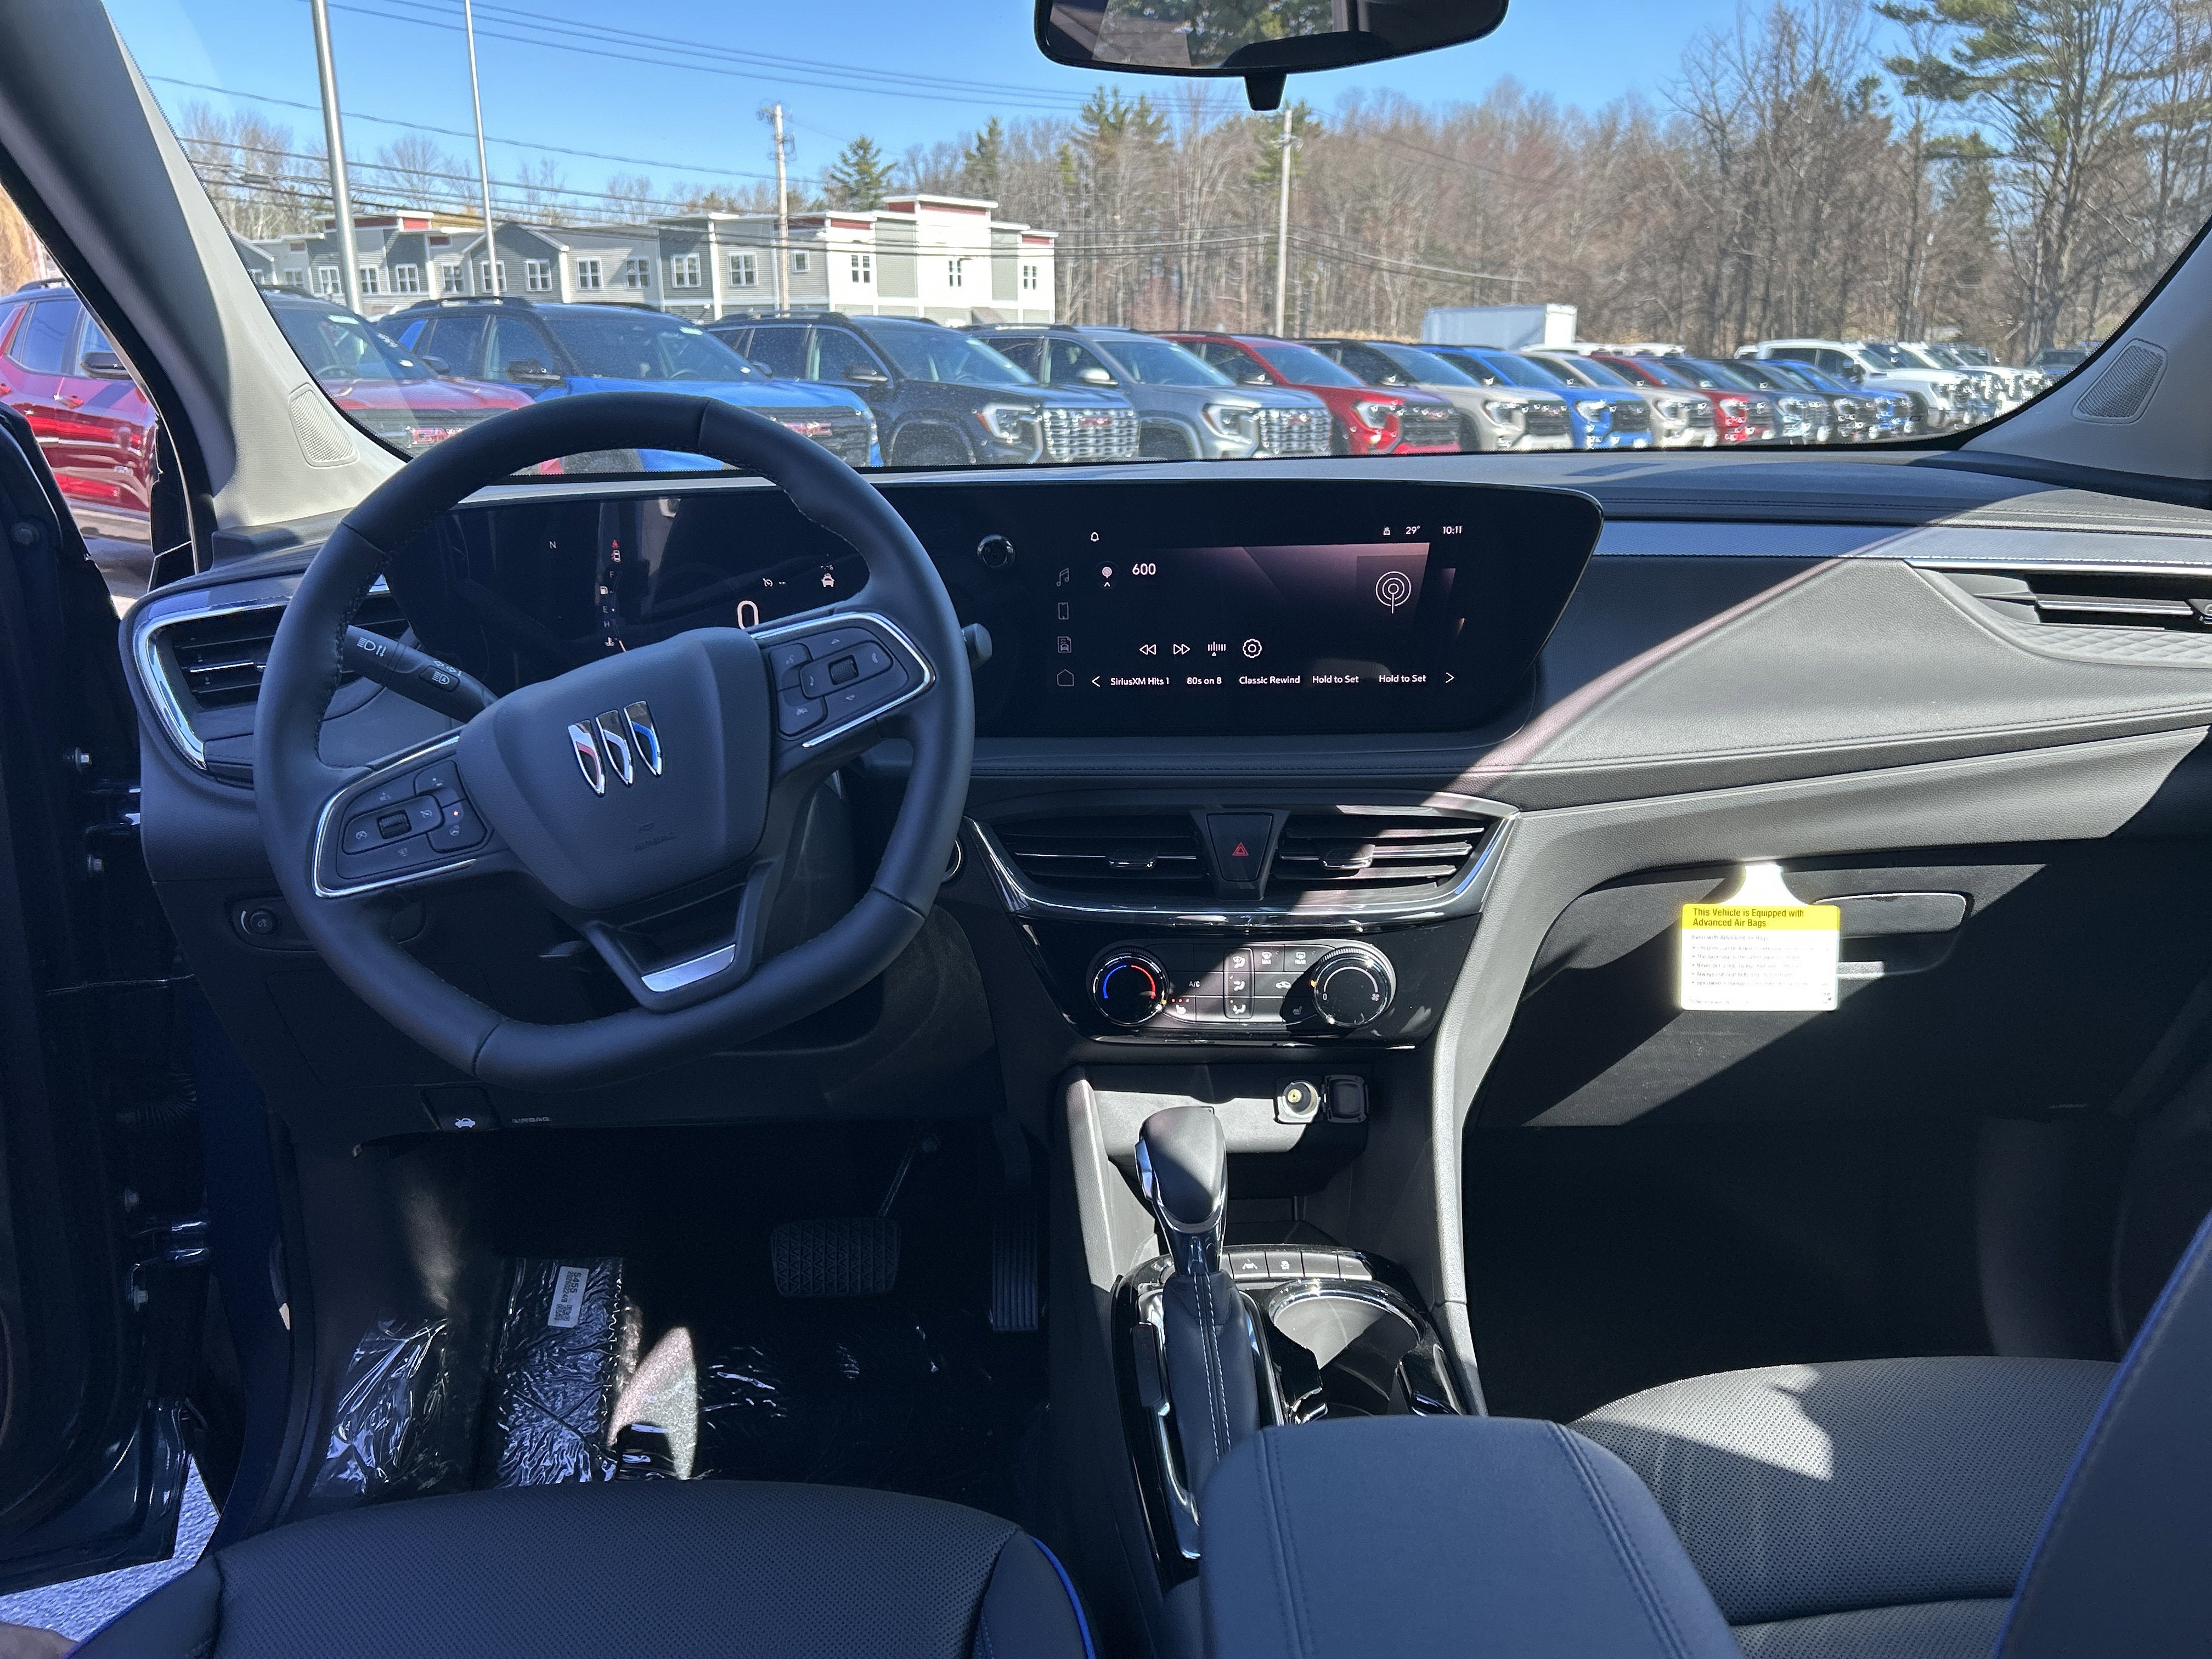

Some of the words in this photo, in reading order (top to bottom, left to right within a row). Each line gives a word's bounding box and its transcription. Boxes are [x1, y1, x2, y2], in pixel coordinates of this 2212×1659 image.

[1406, 525, 1420, 534] 29°
[1442, 526, 1462, 534] 10:11
[549, 540, 557, 549] N
[1132, 563, 1156, 575] 600
[737, 600, 759, 630] 0
[1110, 677, 1146, 686] SiriusXM
[1148, 677, 1164, 685] Hits
[1187, 676, 1203, 685] 80s
[1216, 676, 1222, 685] 8
[1239, 676, 1268, 685] Classic
[1269, 675, 1300, 684] Rewind
[1312, 675, 1332, 684] Hold
[1334, 675, 1343, 684] to
[1345, 675, 1359, 684] Set
[1379, 674, 1399, 682] Hold
[1412, 674, 1426, 682] Set
[1693, 908, 1710, 917] This
[1712, 908, 1741, 917] Vehicle
[1743, 909, 1750, 917] is
[1752, 909, 1786, 919] Equipped
[1788, 910, 1804, 918] with
[1692, 918, 1732, 927] Advanced
[1734, 918, 1746, 927] Air
[1747, 918, 1767, 928] Bags
[570, 1272, 582, 1293] 5455
